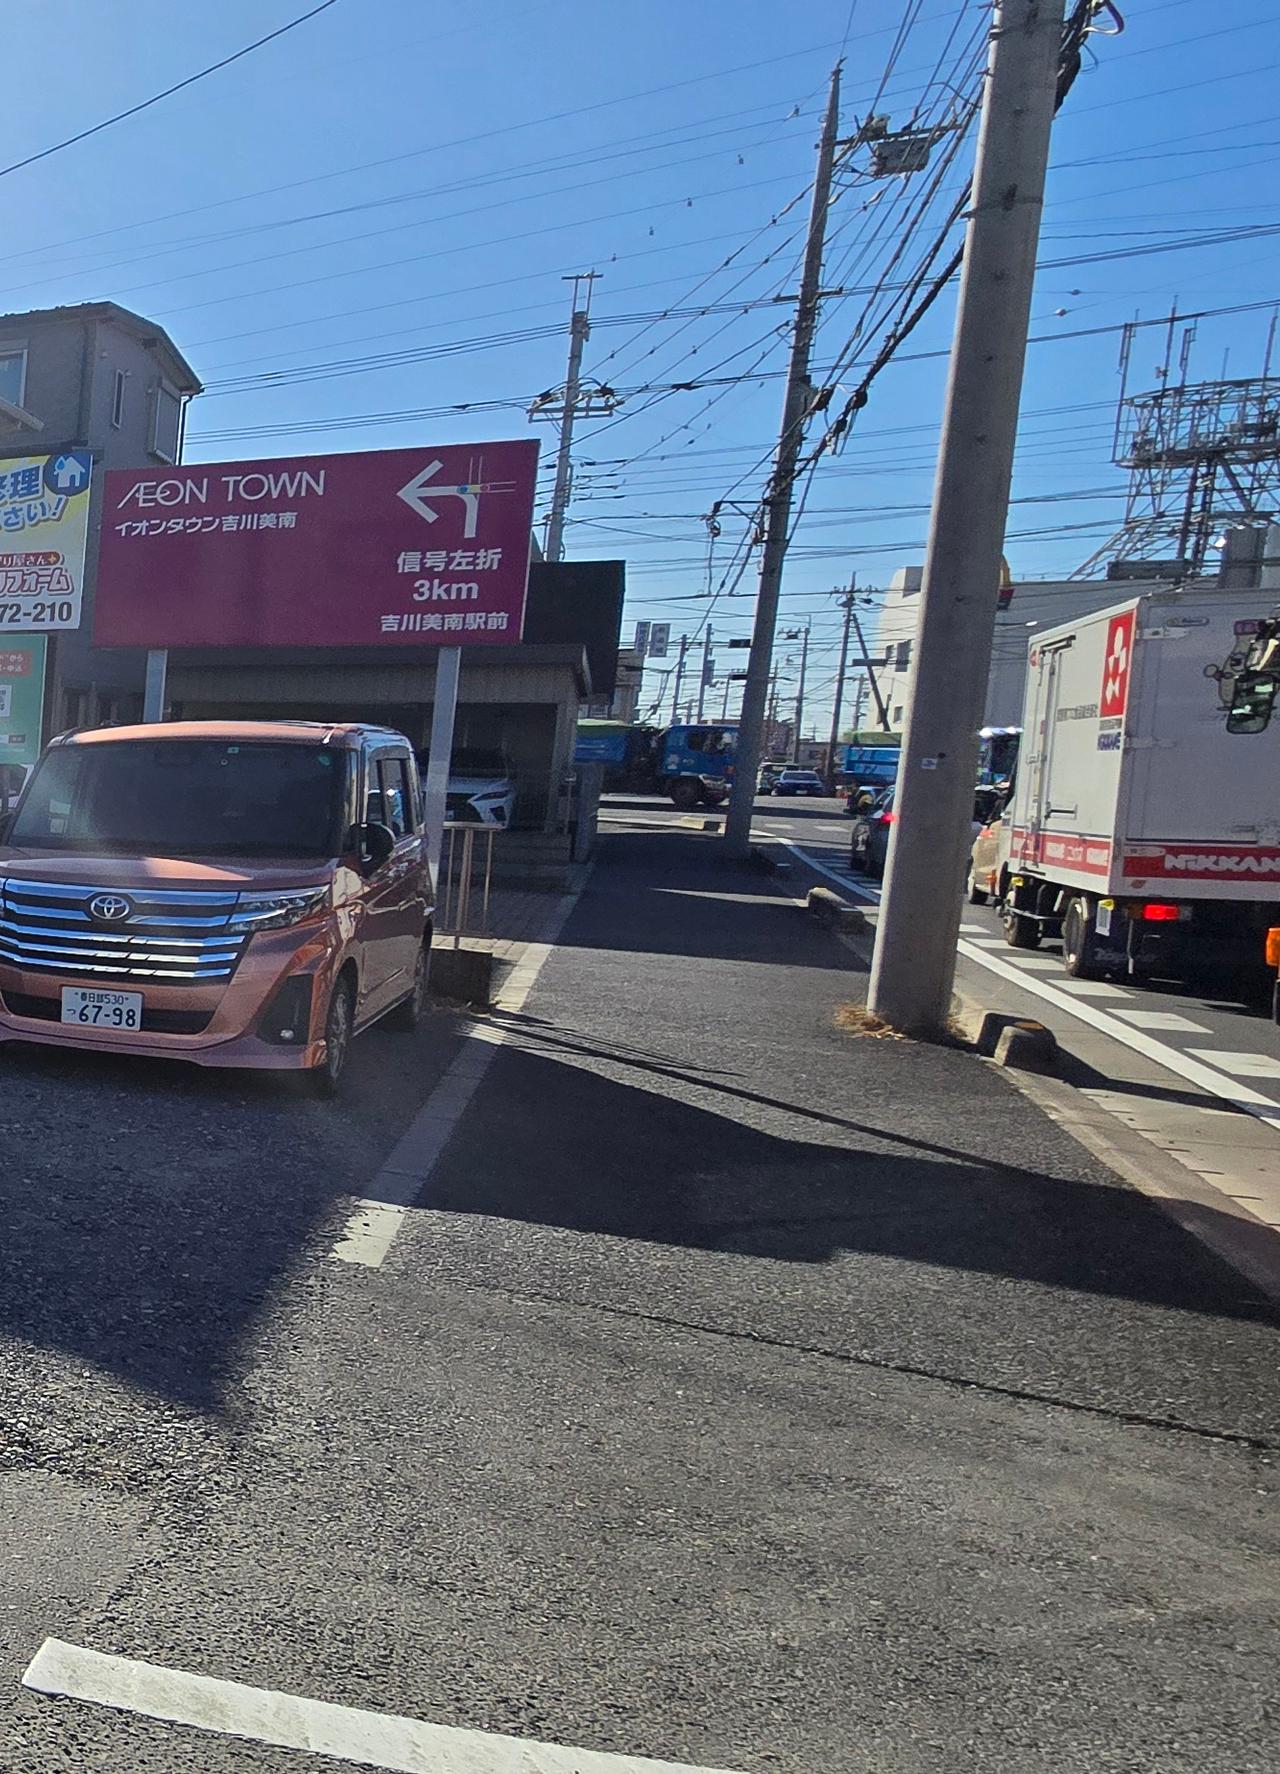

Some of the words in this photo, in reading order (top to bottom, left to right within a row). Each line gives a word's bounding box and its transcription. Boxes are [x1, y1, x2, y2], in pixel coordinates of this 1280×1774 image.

[222, 470, 326, 502] TOWN
[114, 511, 298, 537] イオンタウン吉川美南
[397, 548, 503, 573] 信号左折
[413, 579, 478, 602] 3km
[380, 611, 509, 633] 吉川美南駅前
[78, 1004, 136, 1027] 67-98
